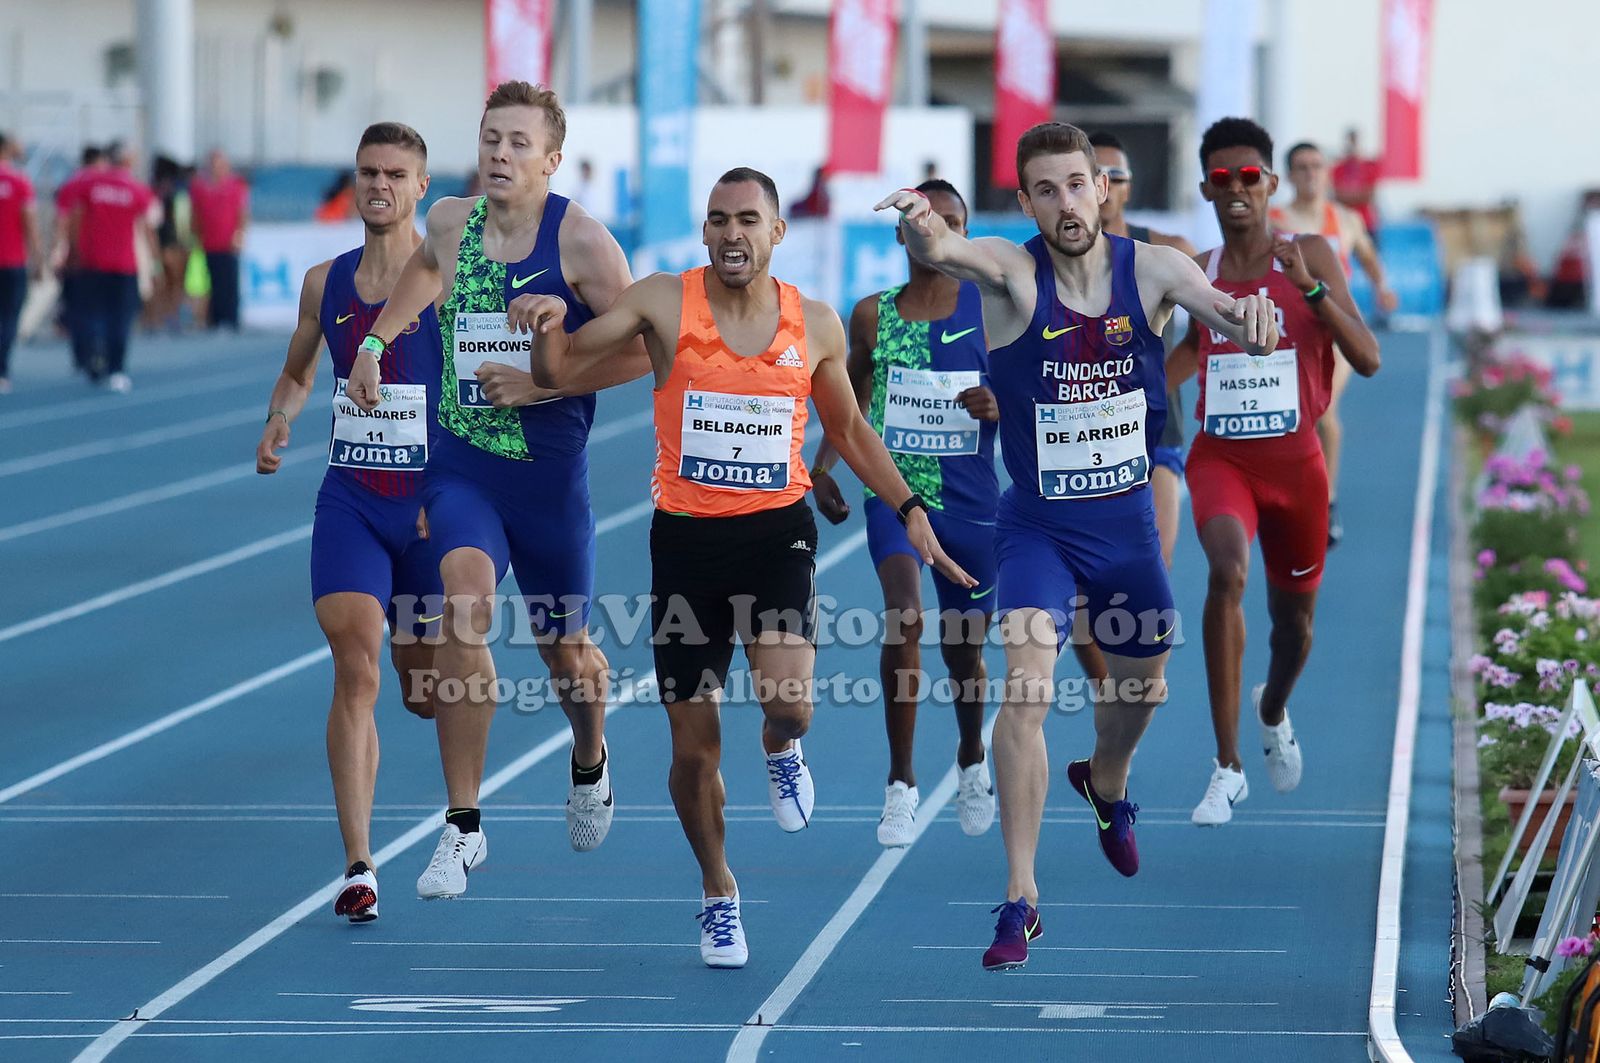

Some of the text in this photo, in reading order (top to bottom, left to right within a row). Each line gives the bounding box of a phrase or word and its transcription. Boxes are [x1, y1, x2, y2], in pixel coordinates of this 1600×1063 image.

[775, 358, 804, 368] adidas
[1042, 353, 1134, 381] FUNDACIÓ
[1219, 377, 1280, 391] HASSAN
[1058, 380, 1121, 402] BARÇA
[704, 396, 746, 405] DIPUTACIÓN
[1240, 400, 1258, 411] 12
[339, 404, 417, 421] VALLADARES
[1068, 413, 1096, 421] HUELVA
[918, 414, 944, 425] 100
[693, 419, 783, 436] BELBACHIR
[1046, 420, 1140, 444] DE ARRIBA
[366, 431, 385, 443] 11
[732, 446, 743, 460] 7
[1092, 453, 1103, 466] 3
